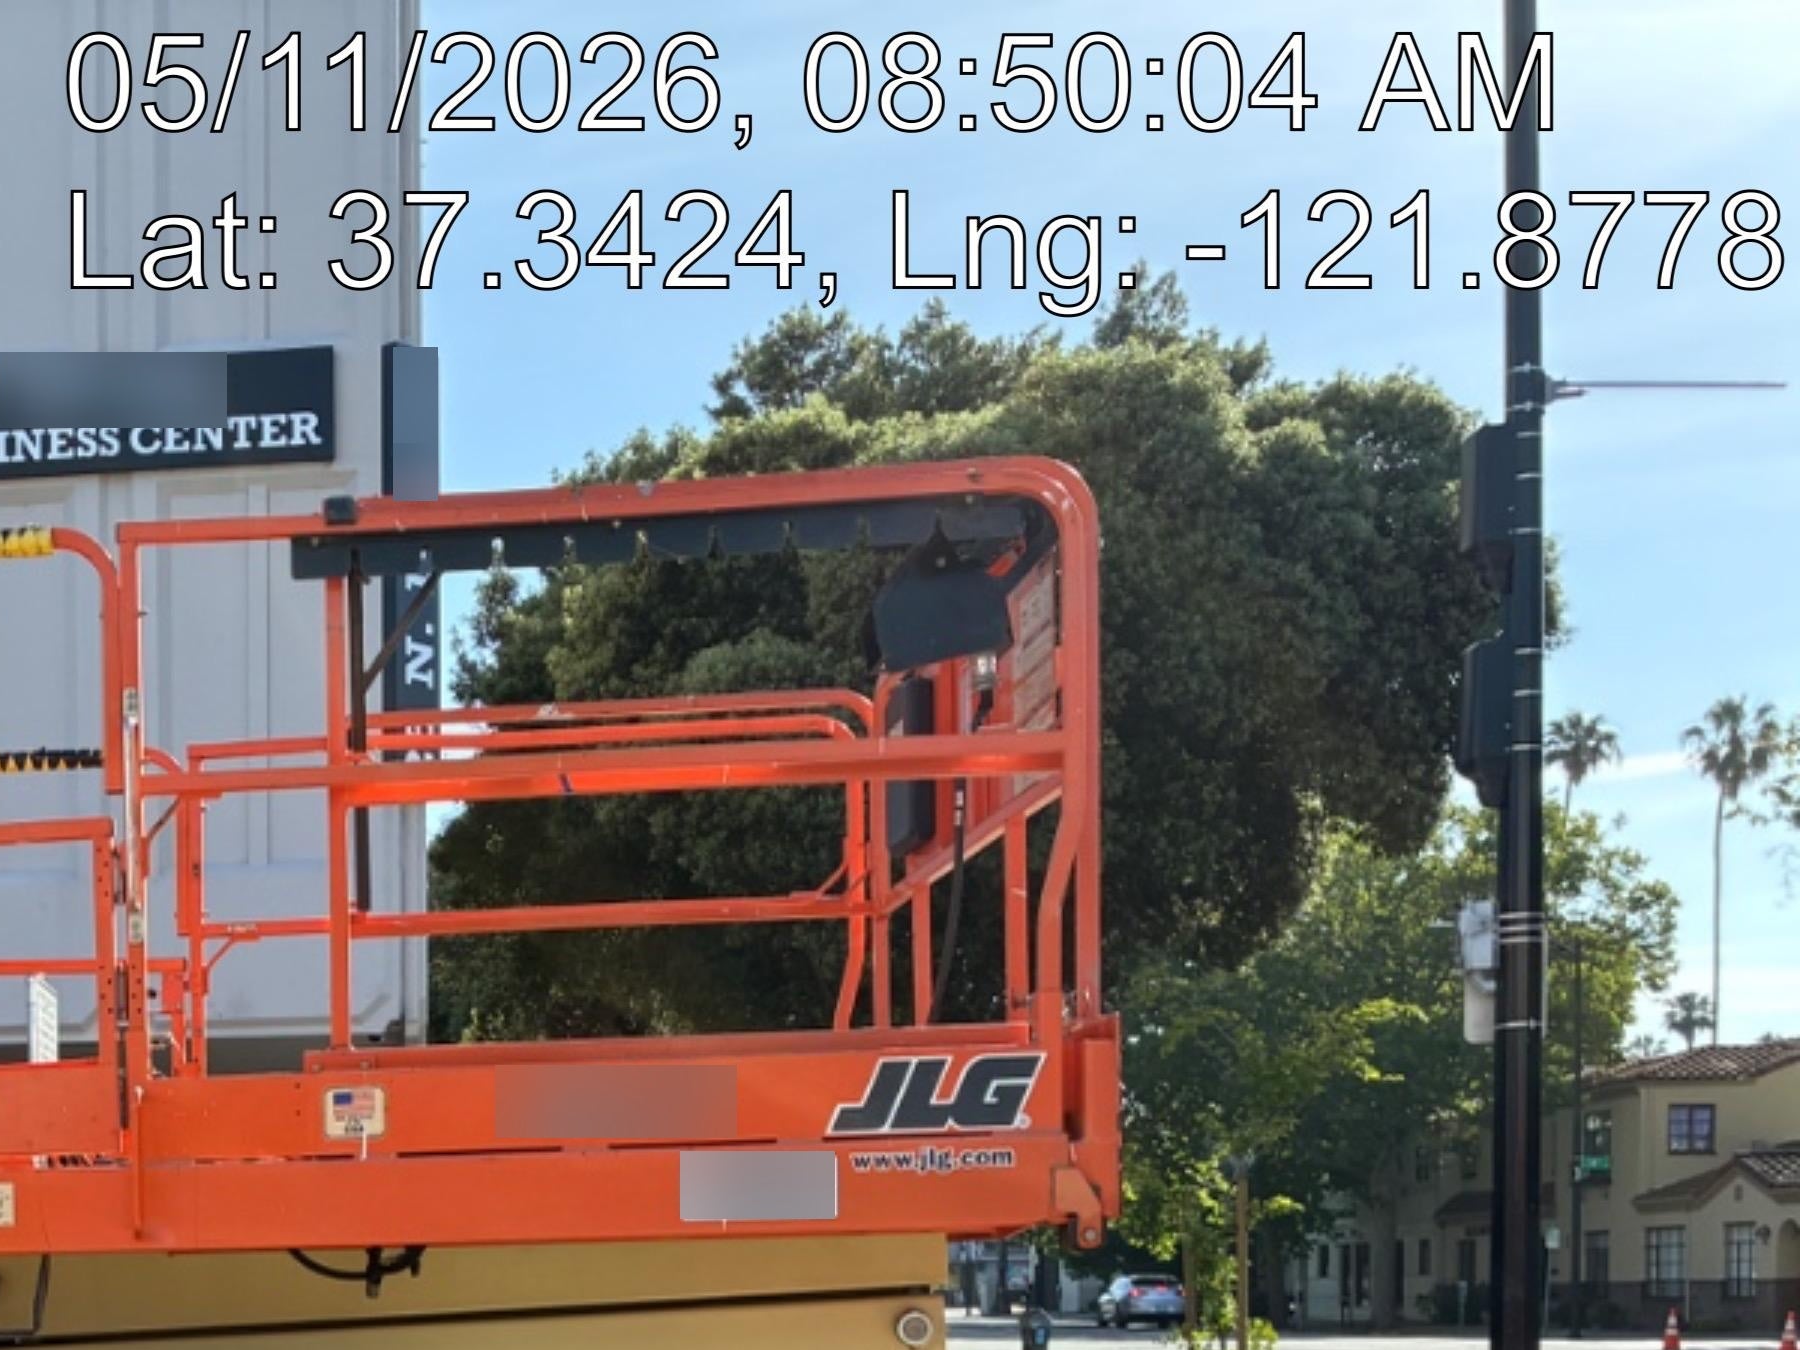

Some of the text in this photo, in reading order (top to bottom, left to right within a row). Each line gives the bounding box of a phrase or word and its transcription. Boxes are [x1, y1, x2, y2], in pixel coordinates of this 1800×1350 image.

[128, 410, 323, 454] CENTER
[825, 1051, 1048, 1137] JLG
[850, 1146, 1015, 1174] www.jlg.com
